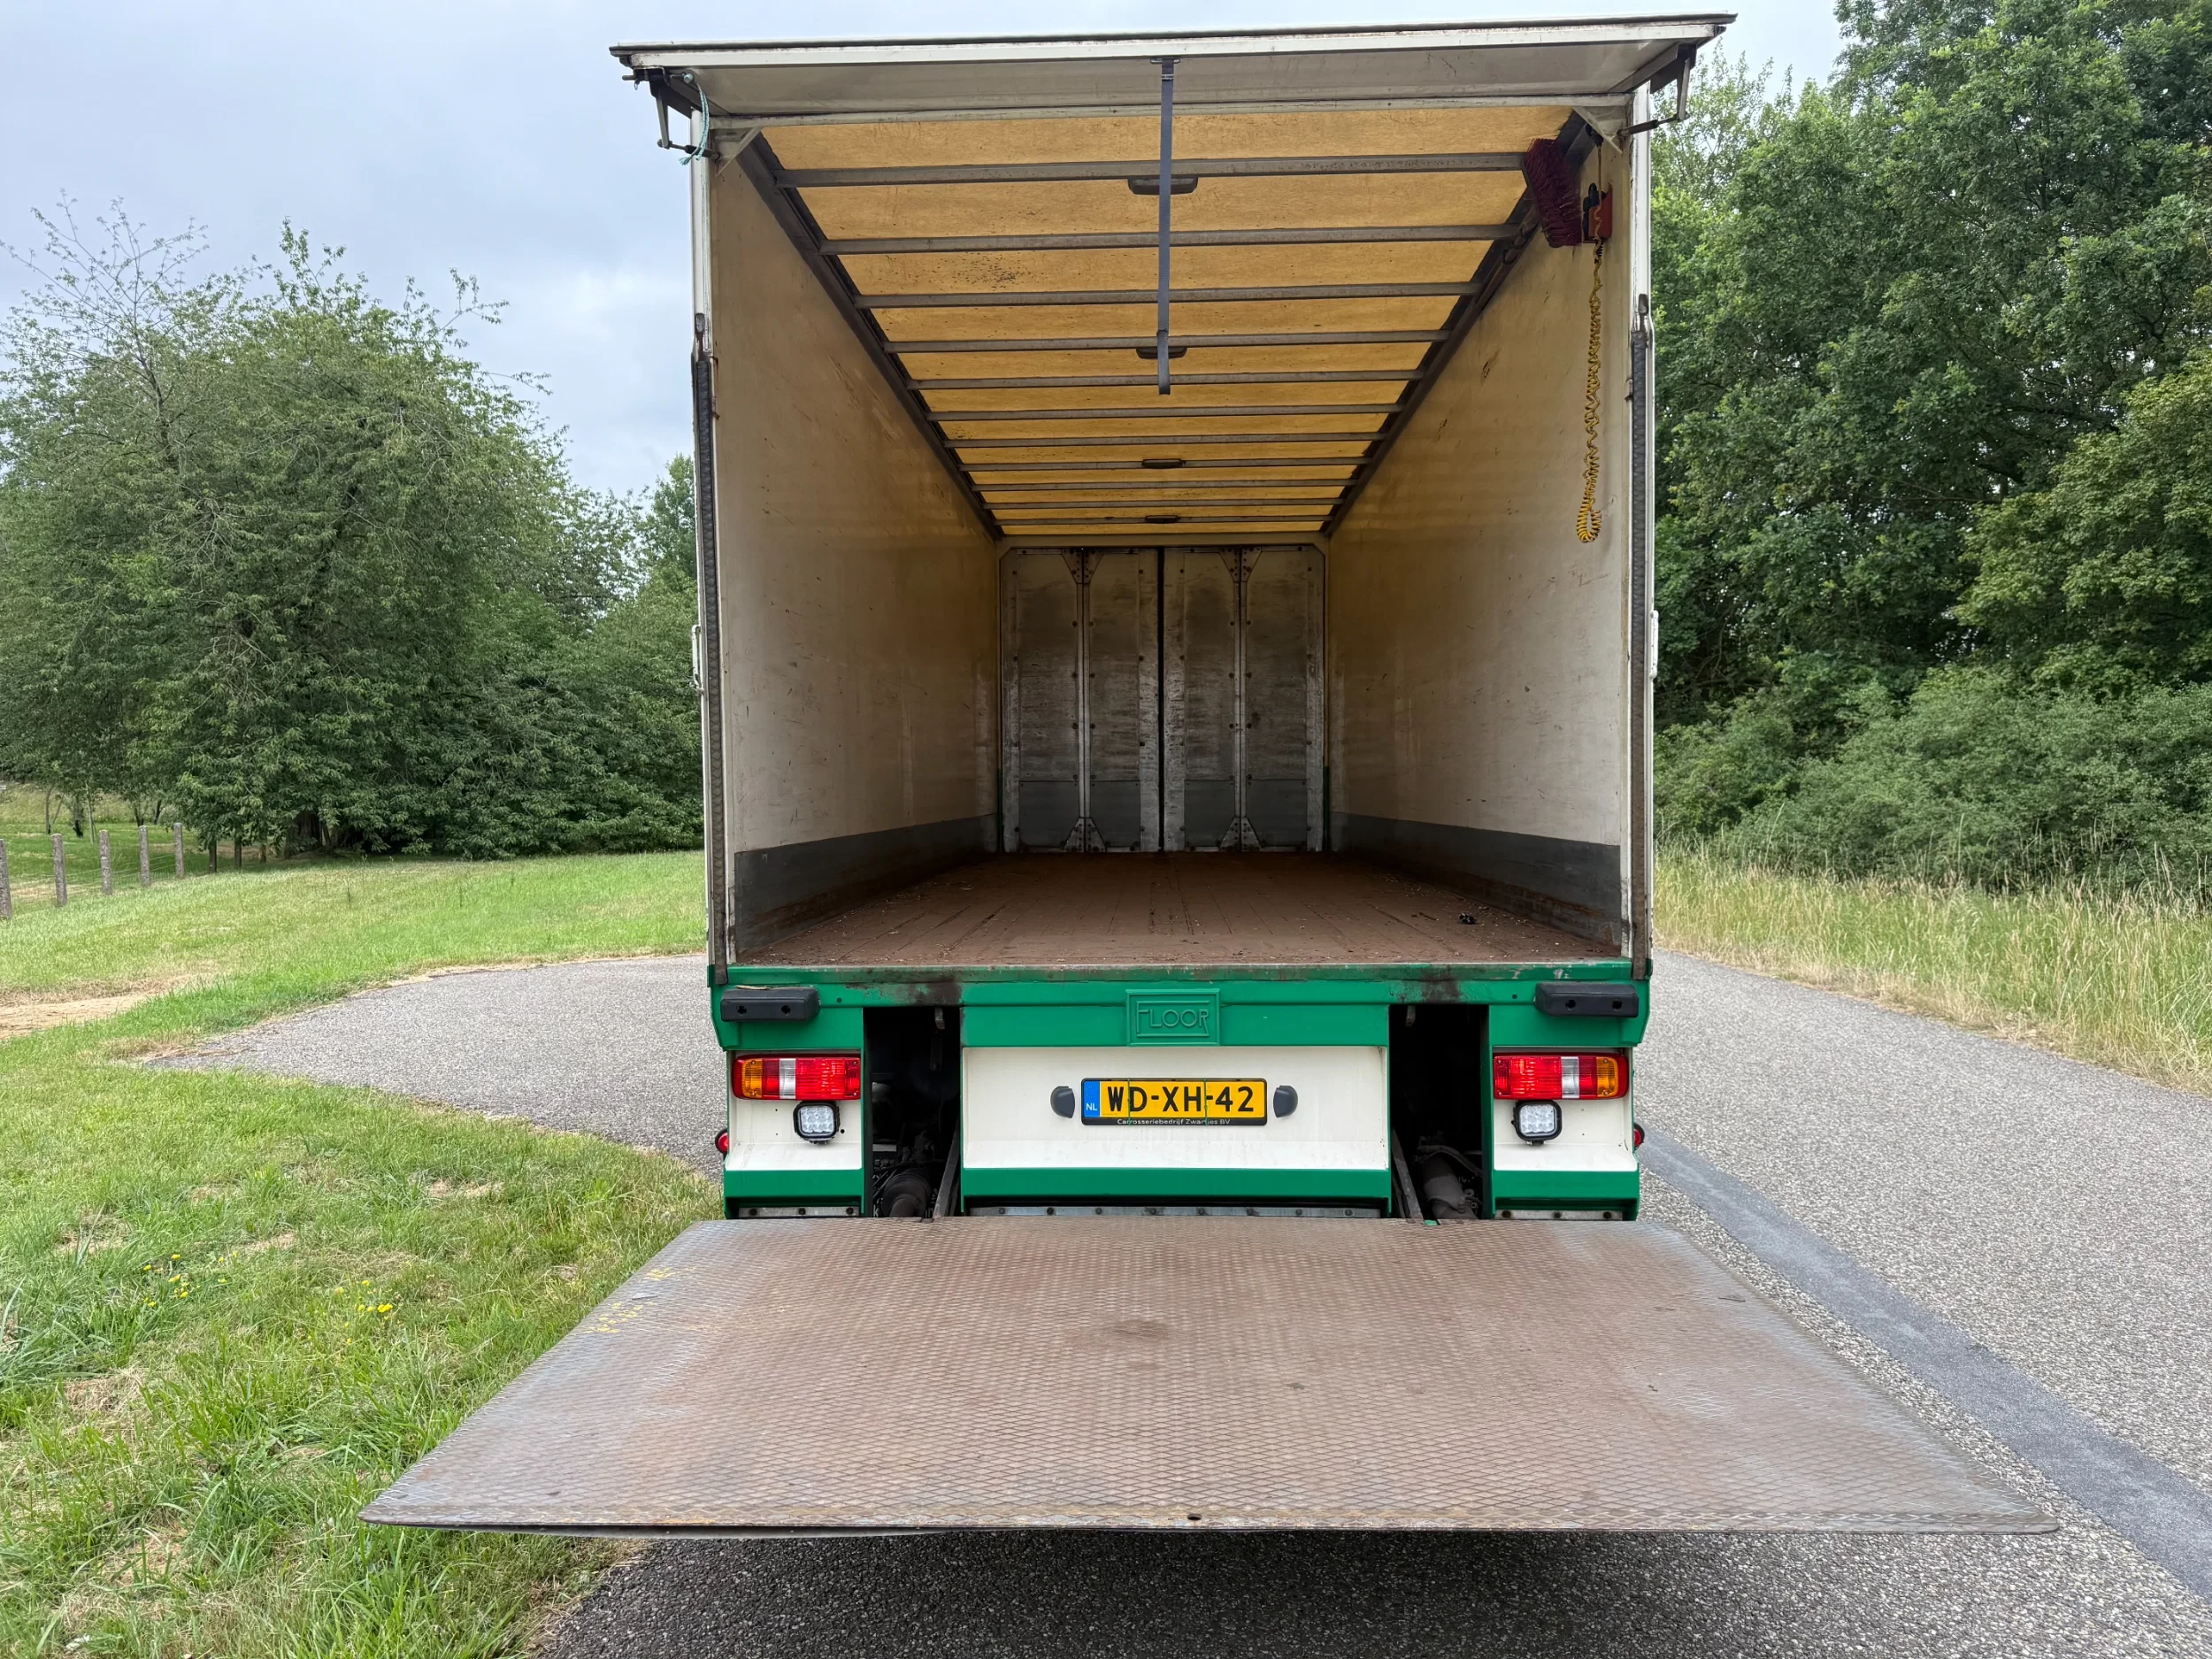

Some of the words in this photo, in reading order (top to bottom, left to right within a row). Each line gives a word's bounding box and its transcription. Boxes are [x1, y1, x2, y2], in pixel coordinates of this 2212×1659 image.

[1136, 1000, 1210, 1037] FLOOR
[1086, 1102, 1098, 1111] NL
[1107, 1087, 1254, 1112] WD-XH-42
